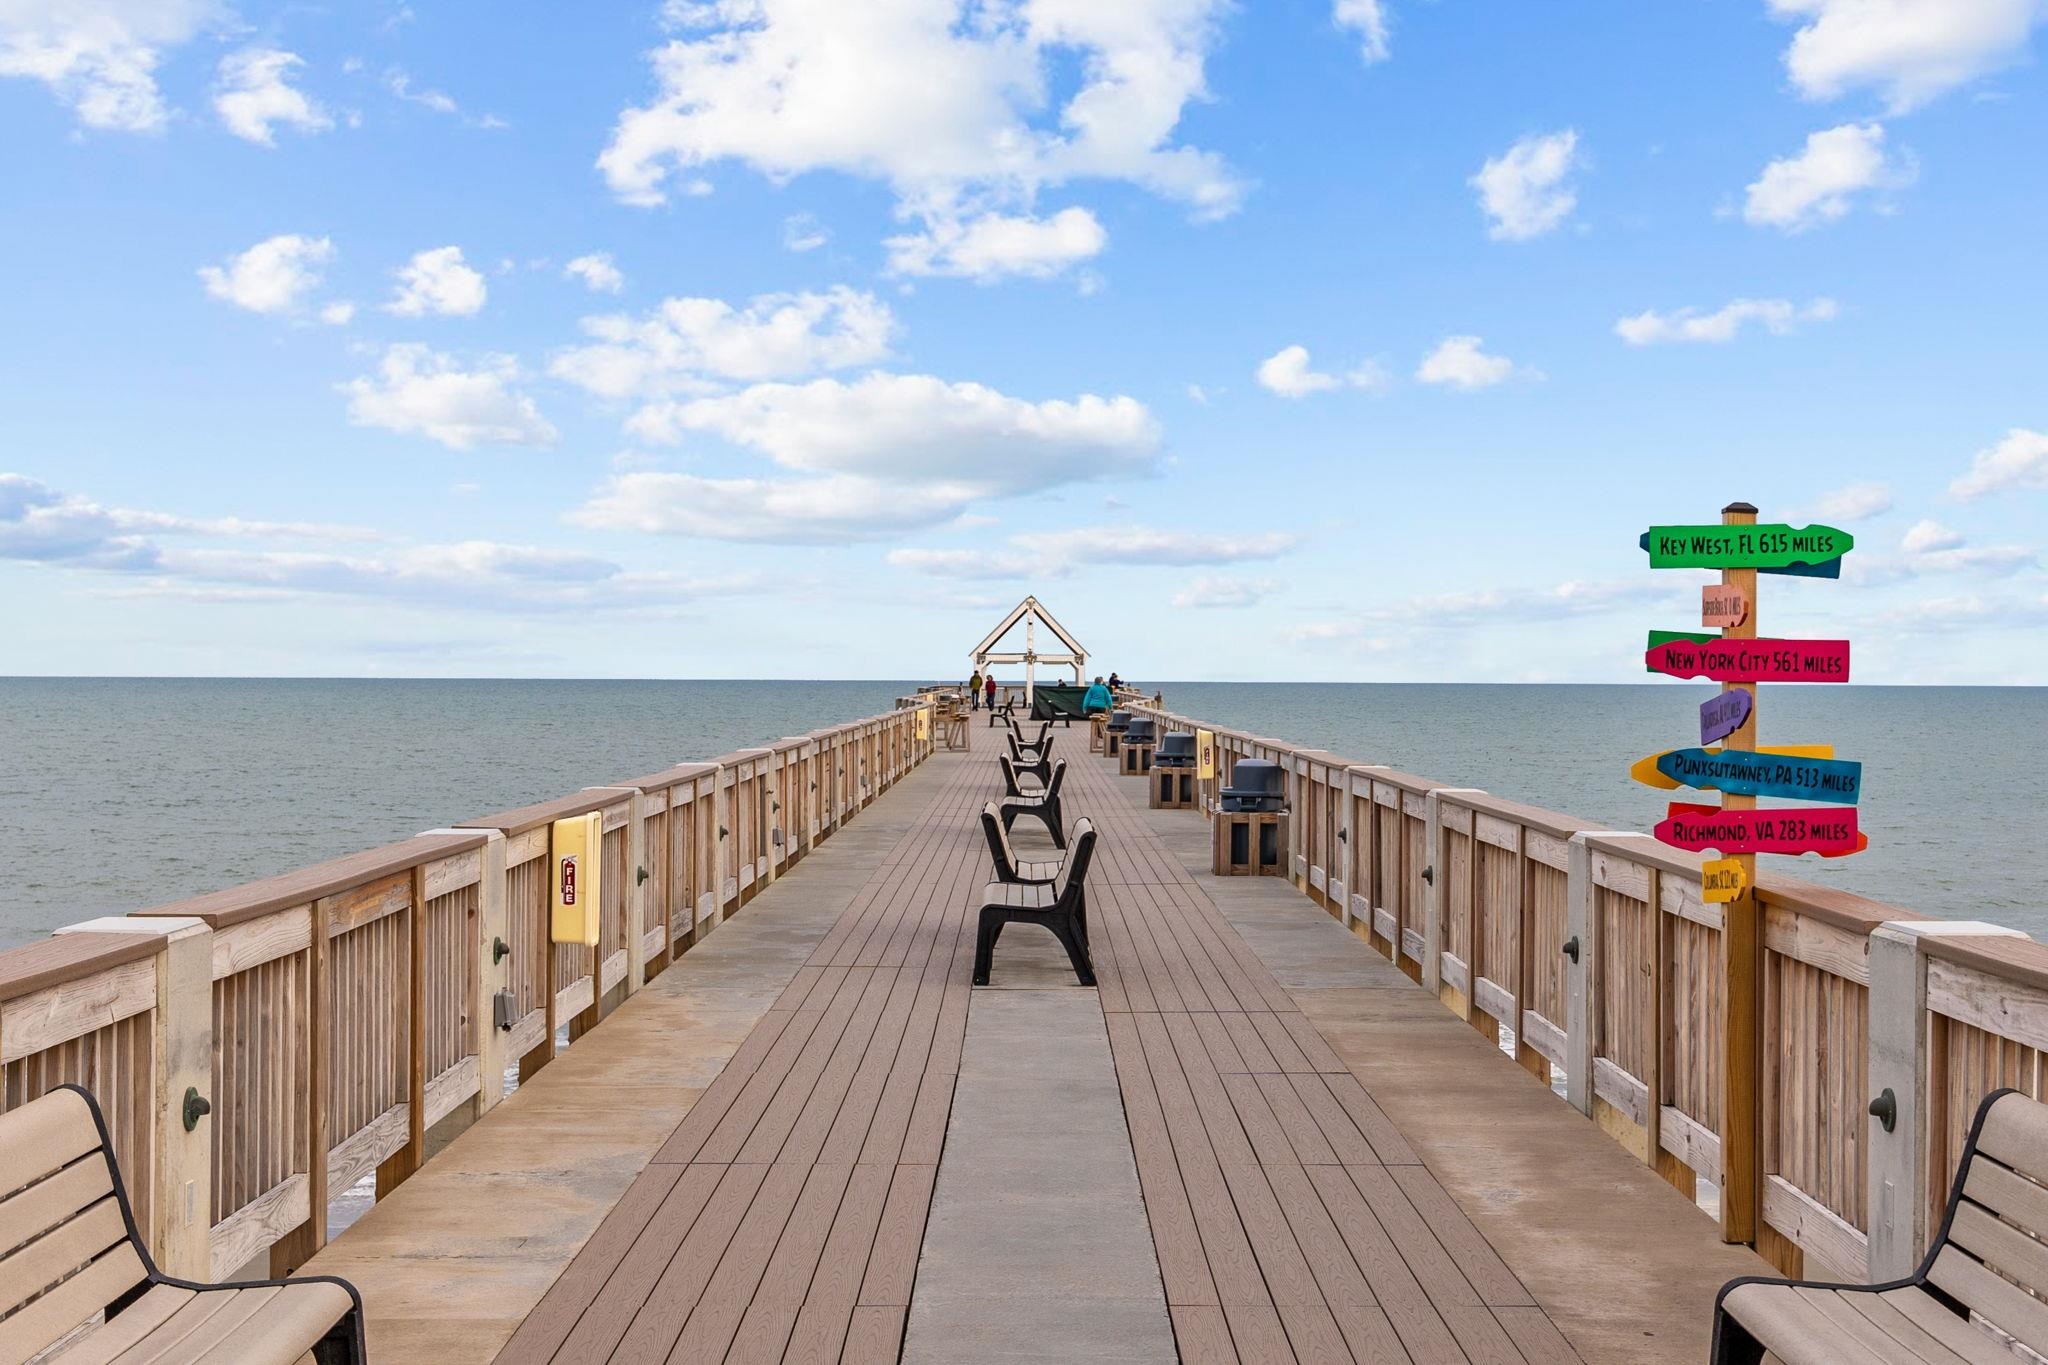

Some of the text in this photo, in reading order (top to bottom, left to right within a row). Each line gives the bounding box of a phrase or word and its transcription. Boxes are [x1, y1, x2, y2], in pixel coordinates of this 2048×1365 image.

[1660, 533, 1833, 556] KEY WEST, FL 615 MILES
[1665, 649, 1841, 674] NEW YORK CITY 561 MILES
[1674, 754, 1856, 793] PUNXSUTAWNEY, PA 513 MILES
[1673, 820, 1849, 842] RICHMOND, VA 283 MILES
[566, 868, 574, 902] FIRE
